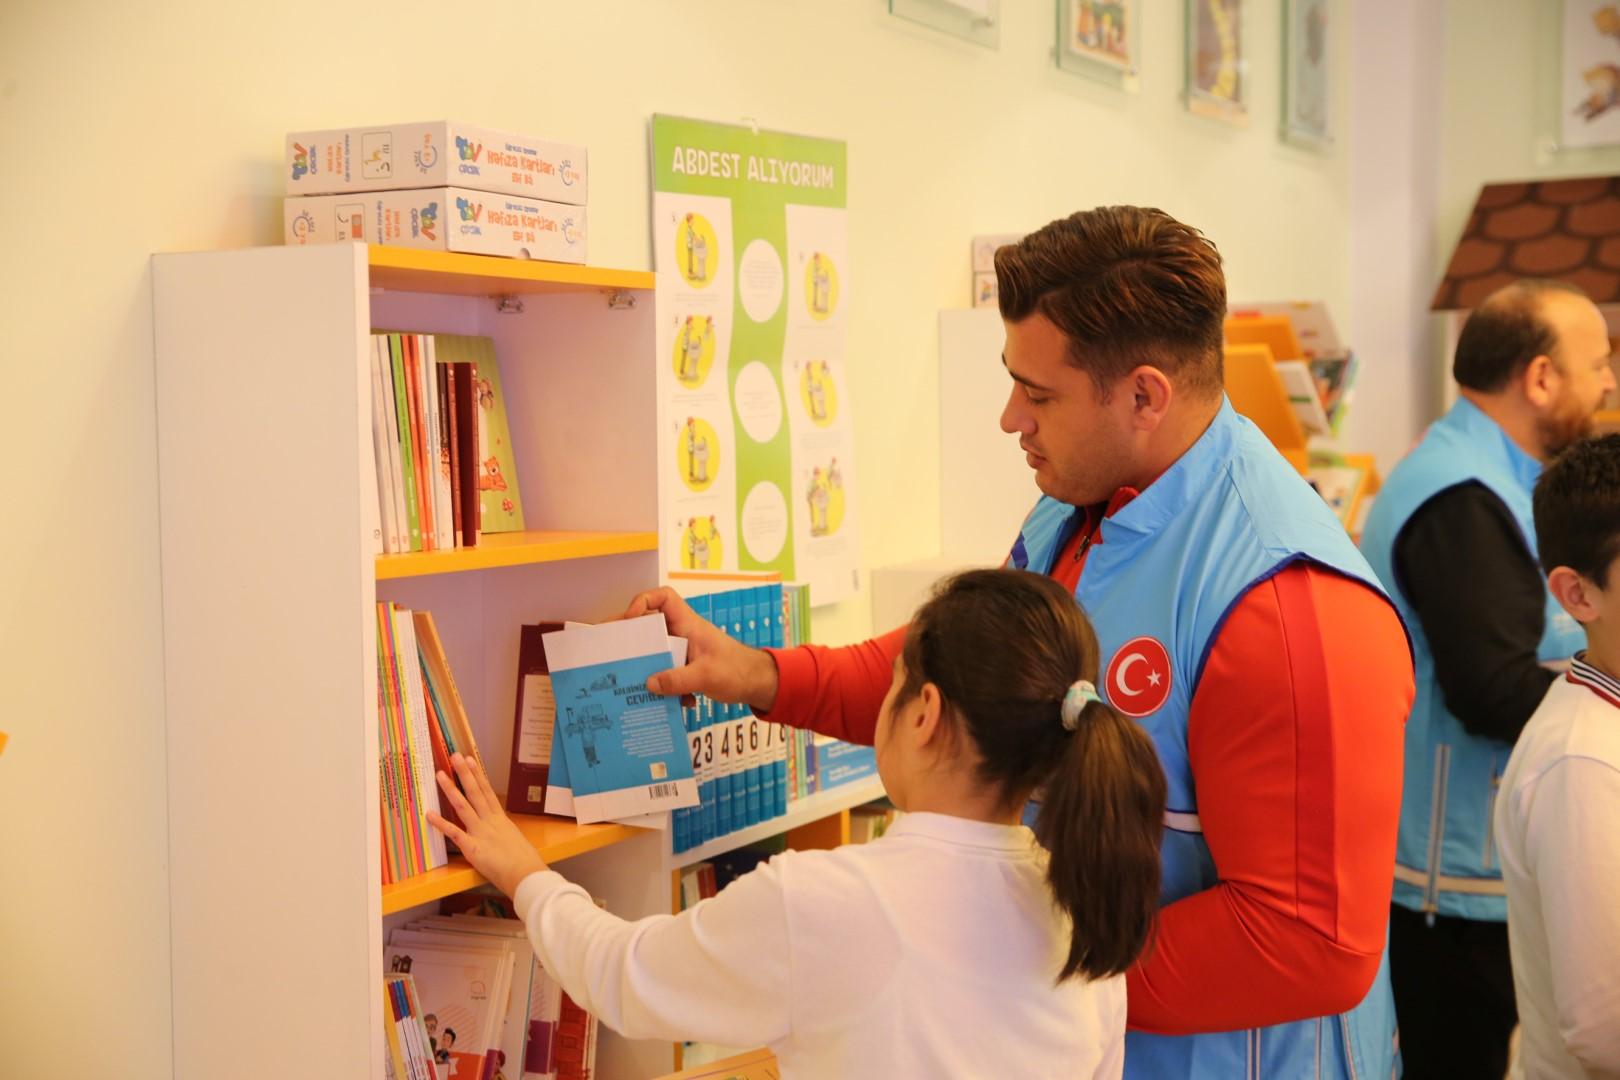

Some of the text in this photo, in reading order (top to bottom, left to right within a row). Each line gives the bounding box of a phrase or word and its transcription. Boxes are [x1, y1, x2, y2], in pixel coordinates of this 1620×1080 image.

[672, 146, 834, 188] ABDEST ALIYORUM
[705, 731, 713, 763] 3
[721, 727, 729, 758] 4
[736, 724, 744, 755] 5
[750, 720, 758, 750] 6
[692, 736, 701, 769] 2
